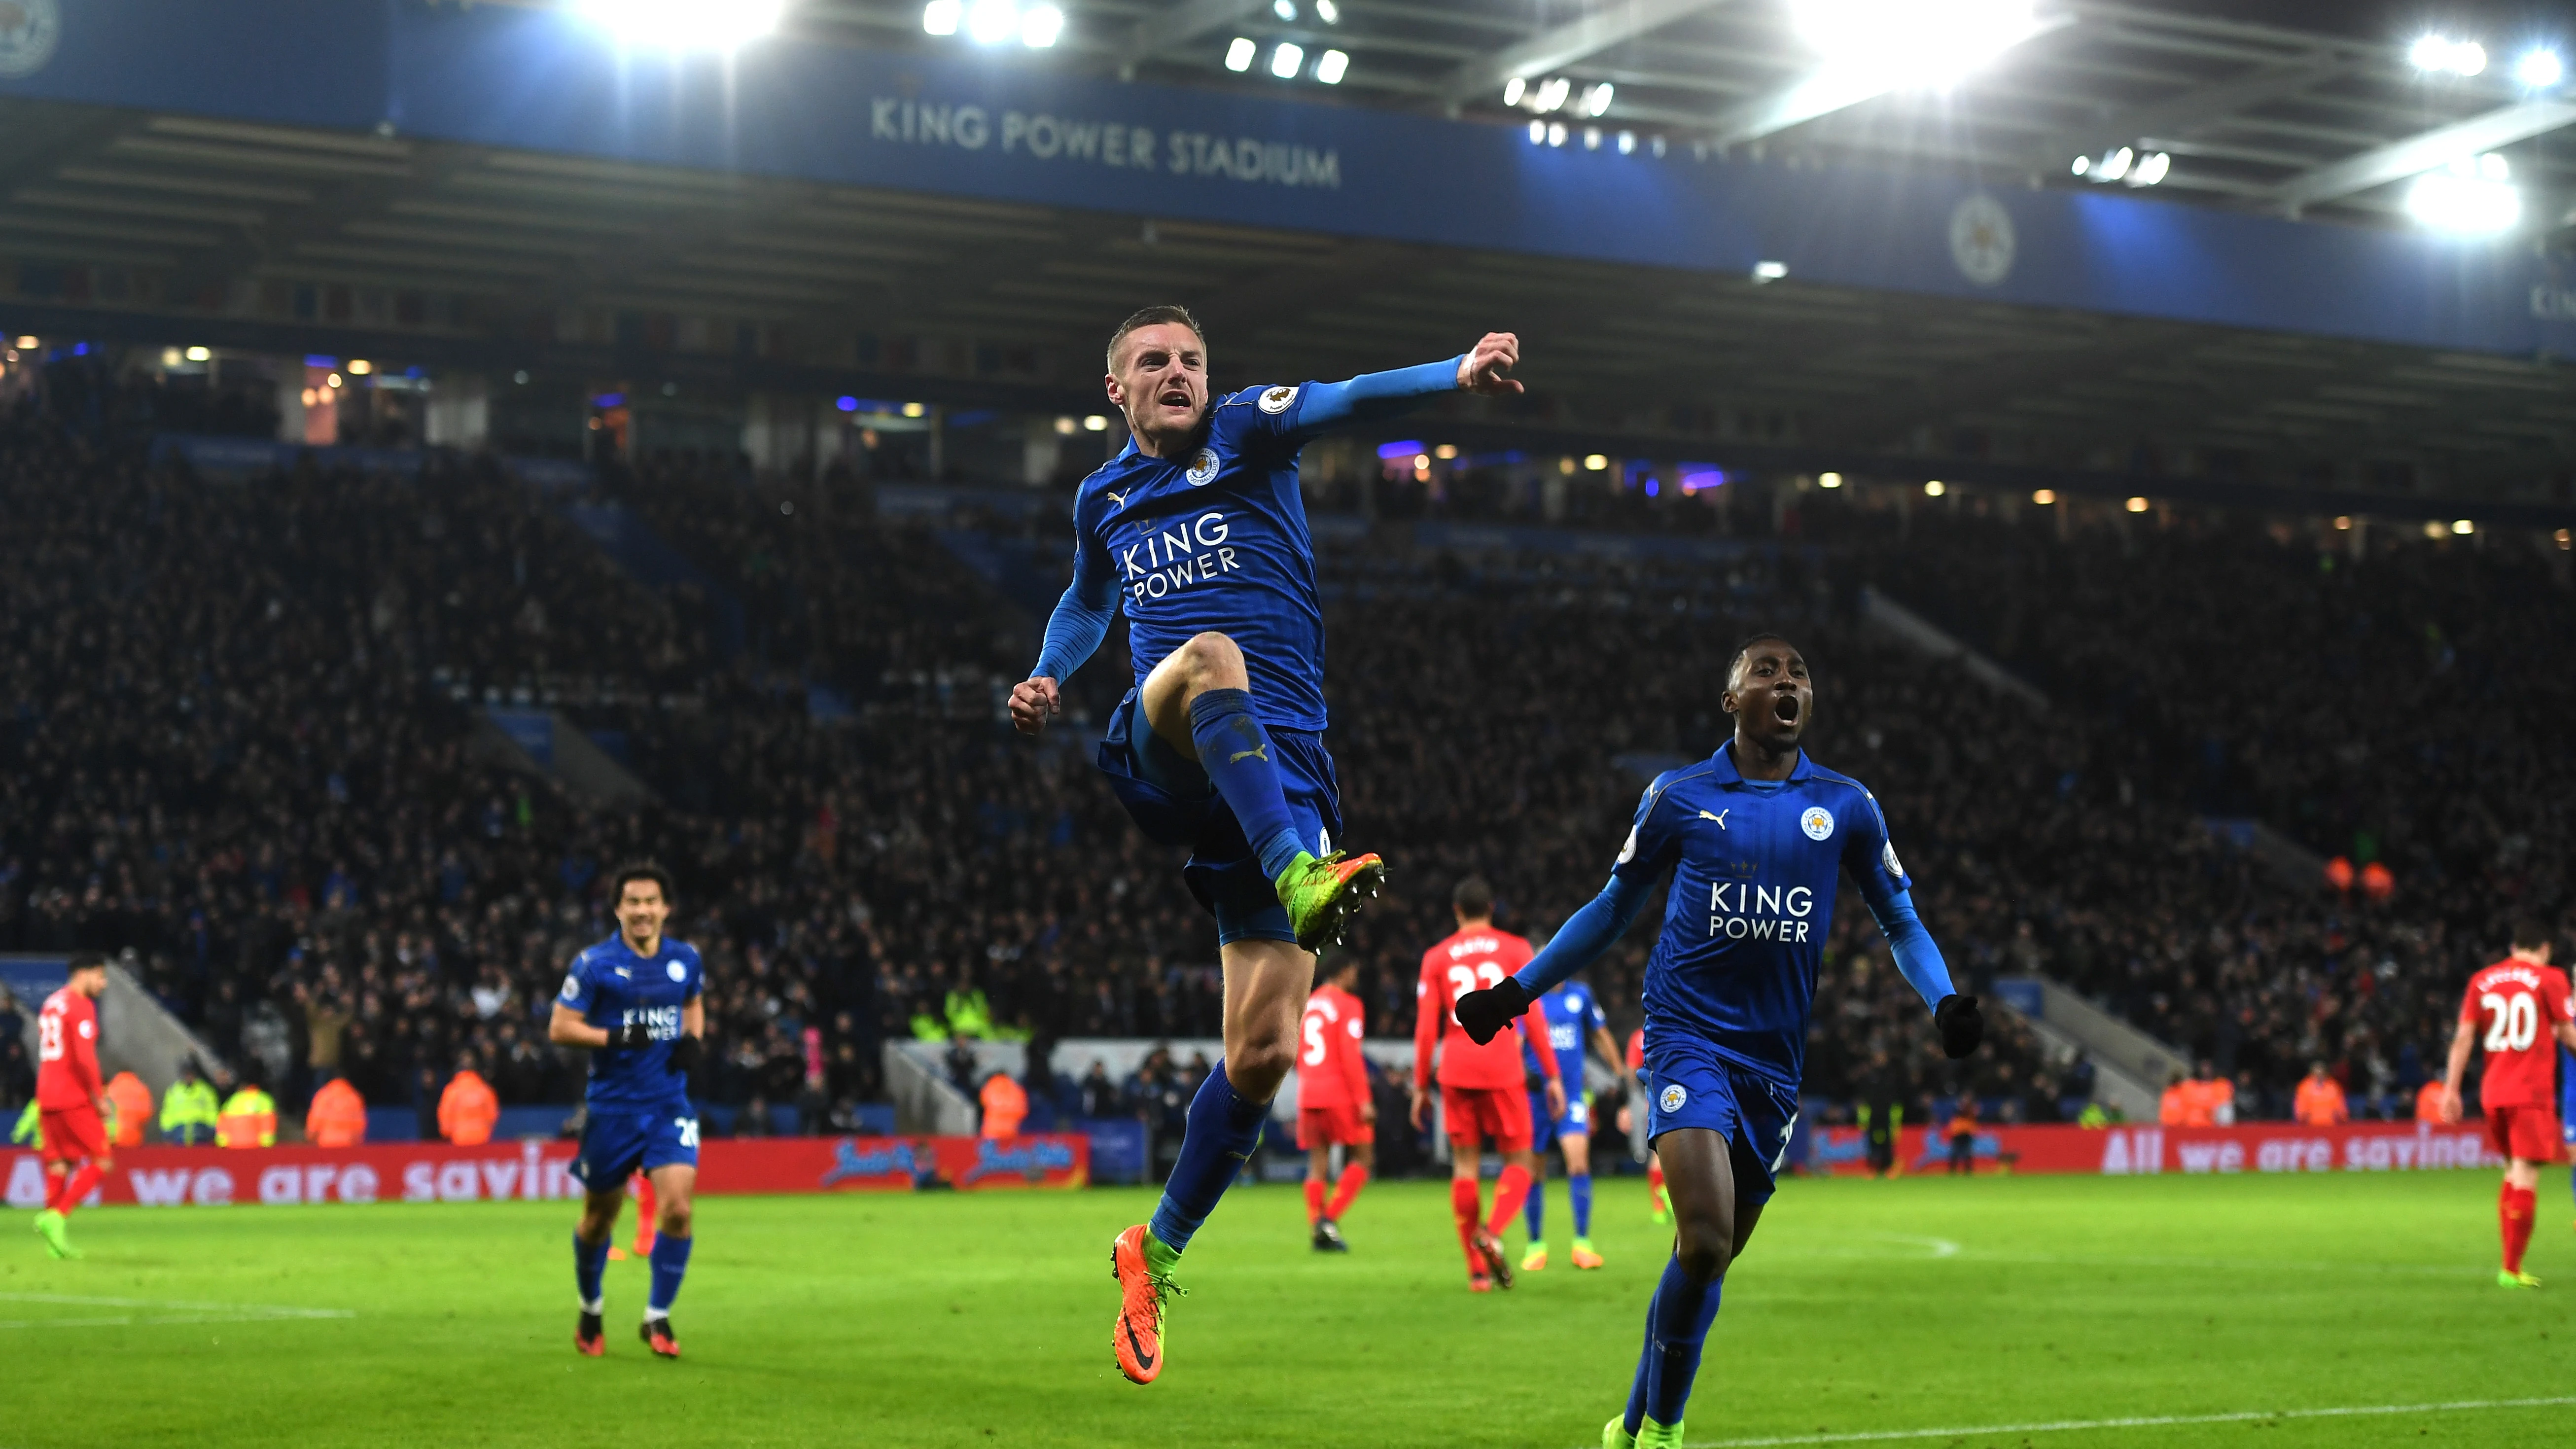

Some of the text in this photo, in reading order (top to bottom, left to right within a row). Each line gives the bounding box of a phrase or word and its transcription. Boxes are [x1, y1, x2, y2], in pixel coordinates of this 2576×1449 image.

[871, 97, 1342, 189] KING POWER STADIUM
[1123, 512, 1229, 580] KING
[1133, 546, 1241, 607] POWER
[1710, 882, 1813, 917] KING
[1709, 915, 1811, 943] POWER
[623, 1006, 677, 1026] KING
[1303, 1015, 1327, 1066] 5
[2480, 992, 2538, 1052] 20
[127, 1166, 236, 1206] we
[257, 1161, 378, 1204] are
[401, 1138, 585, 1202] savin
[2102, 1130, 2165, 1174] All
[2177, 1140, 2244, 1172] we
[2257, 1135, 2333, 1171] are
